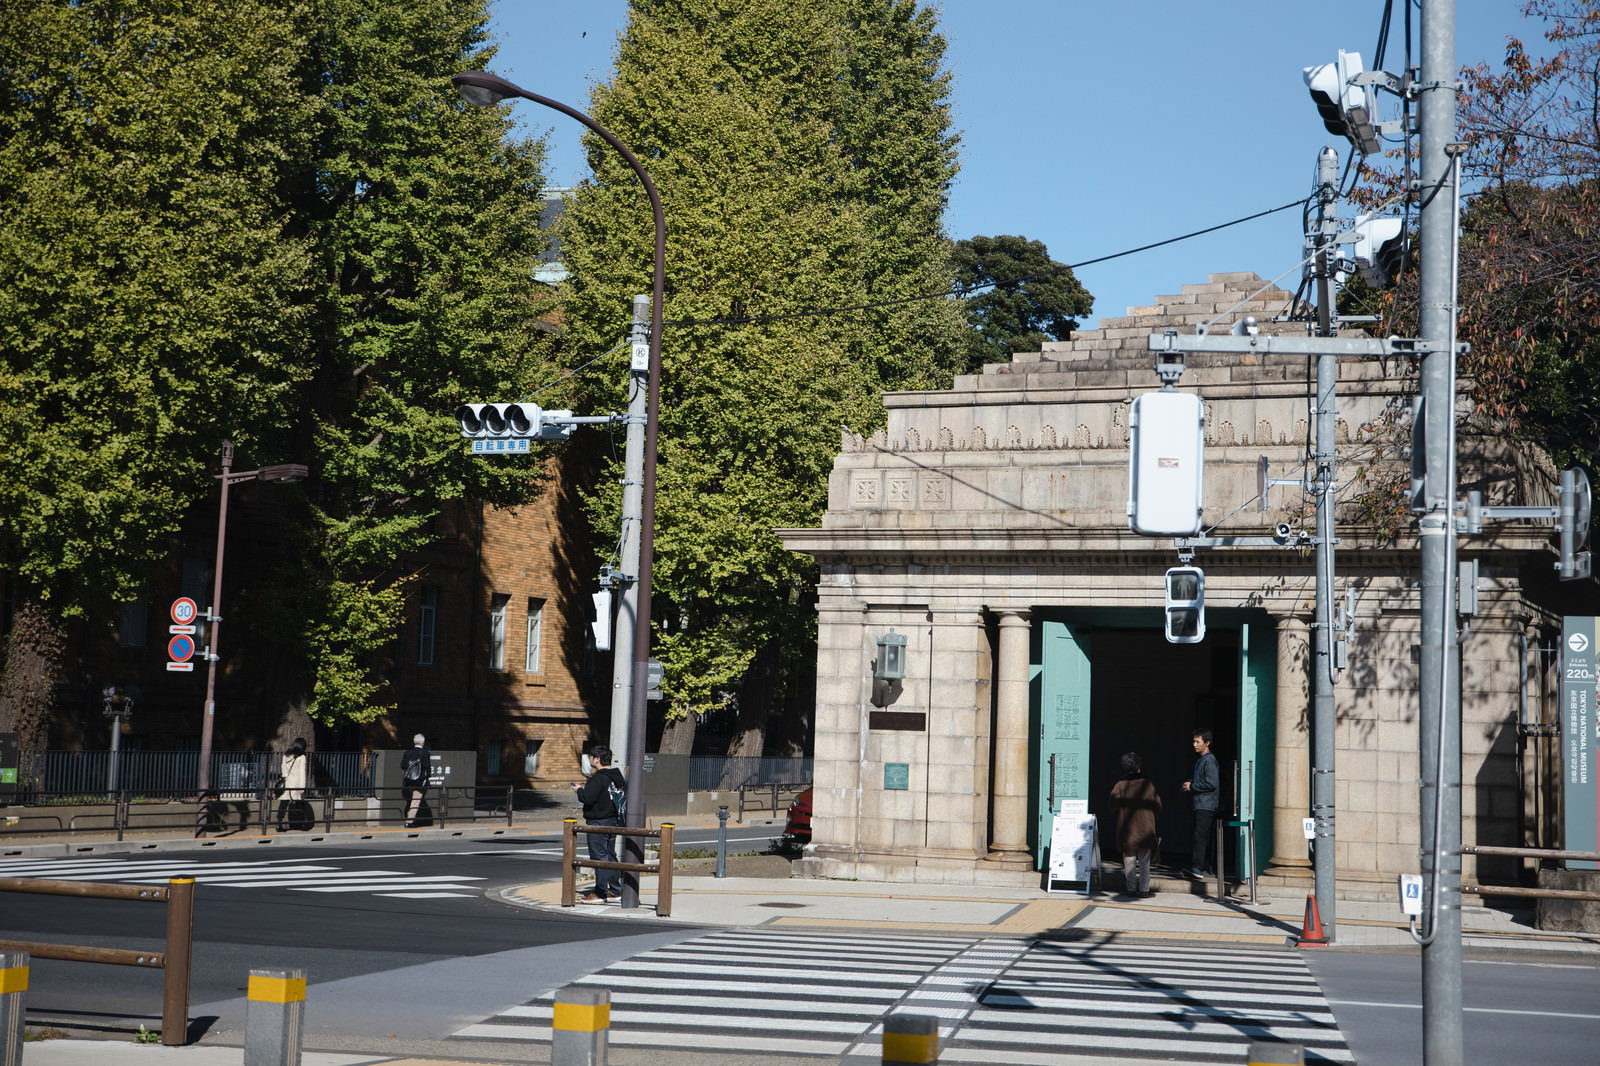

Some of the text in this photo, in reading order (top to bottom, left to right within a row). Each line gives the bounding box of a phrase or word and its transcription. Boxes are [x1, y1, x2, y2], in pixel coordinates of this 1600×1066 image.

[475, 440, 527, 450] 自転車専用
[177, 605, 191, 617] 30
